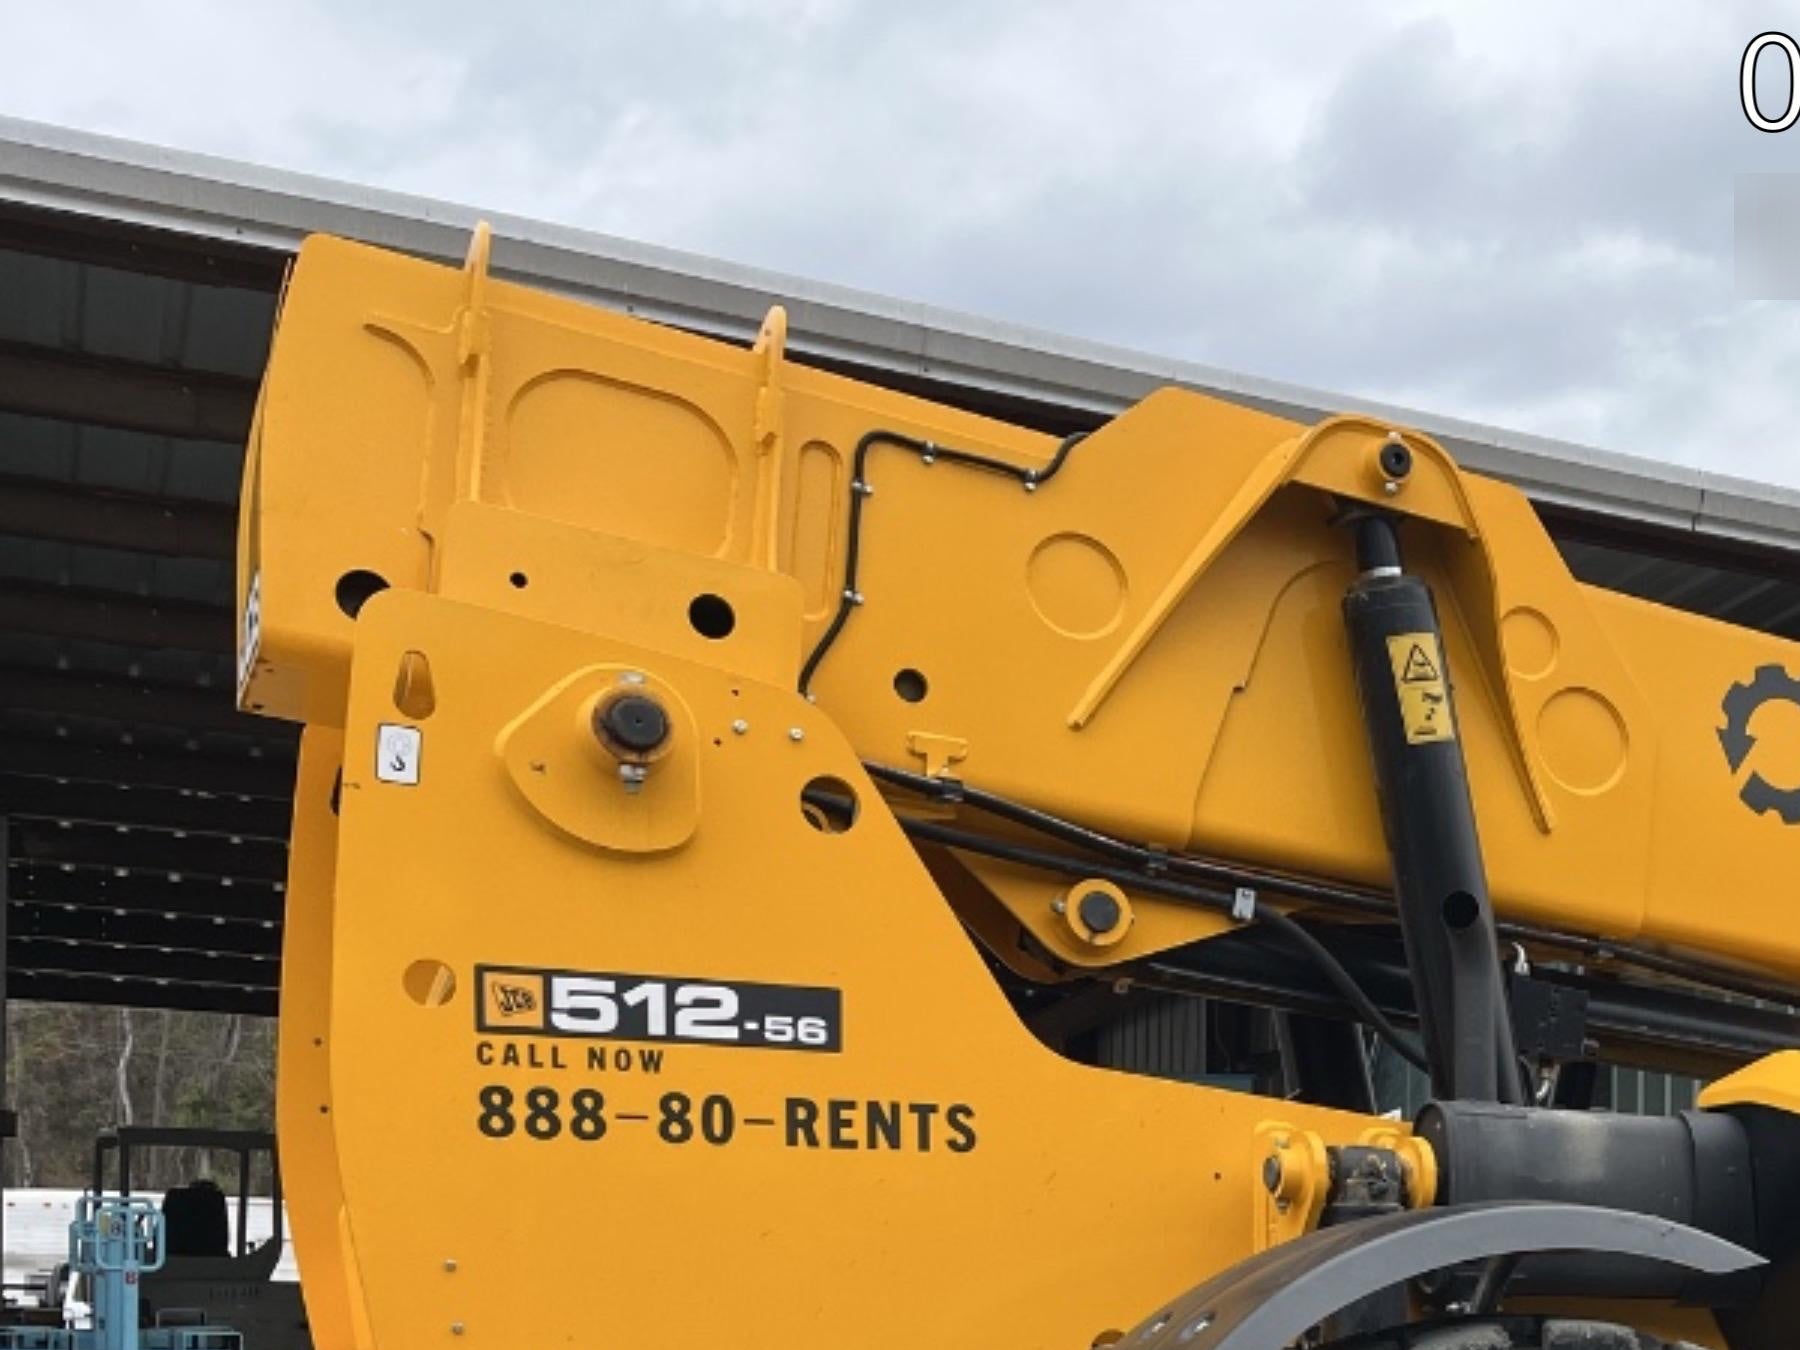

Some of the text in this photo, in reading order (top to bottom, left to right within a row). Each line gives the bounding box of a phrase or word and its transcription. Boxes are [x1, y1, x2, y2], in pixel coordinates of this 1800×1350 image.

[550, 976, 829, 1045] 512-56
[476, 1041, 664, 1073] CALL NOW
[477, 1084, 977, 1153] 888-80-RENTS
